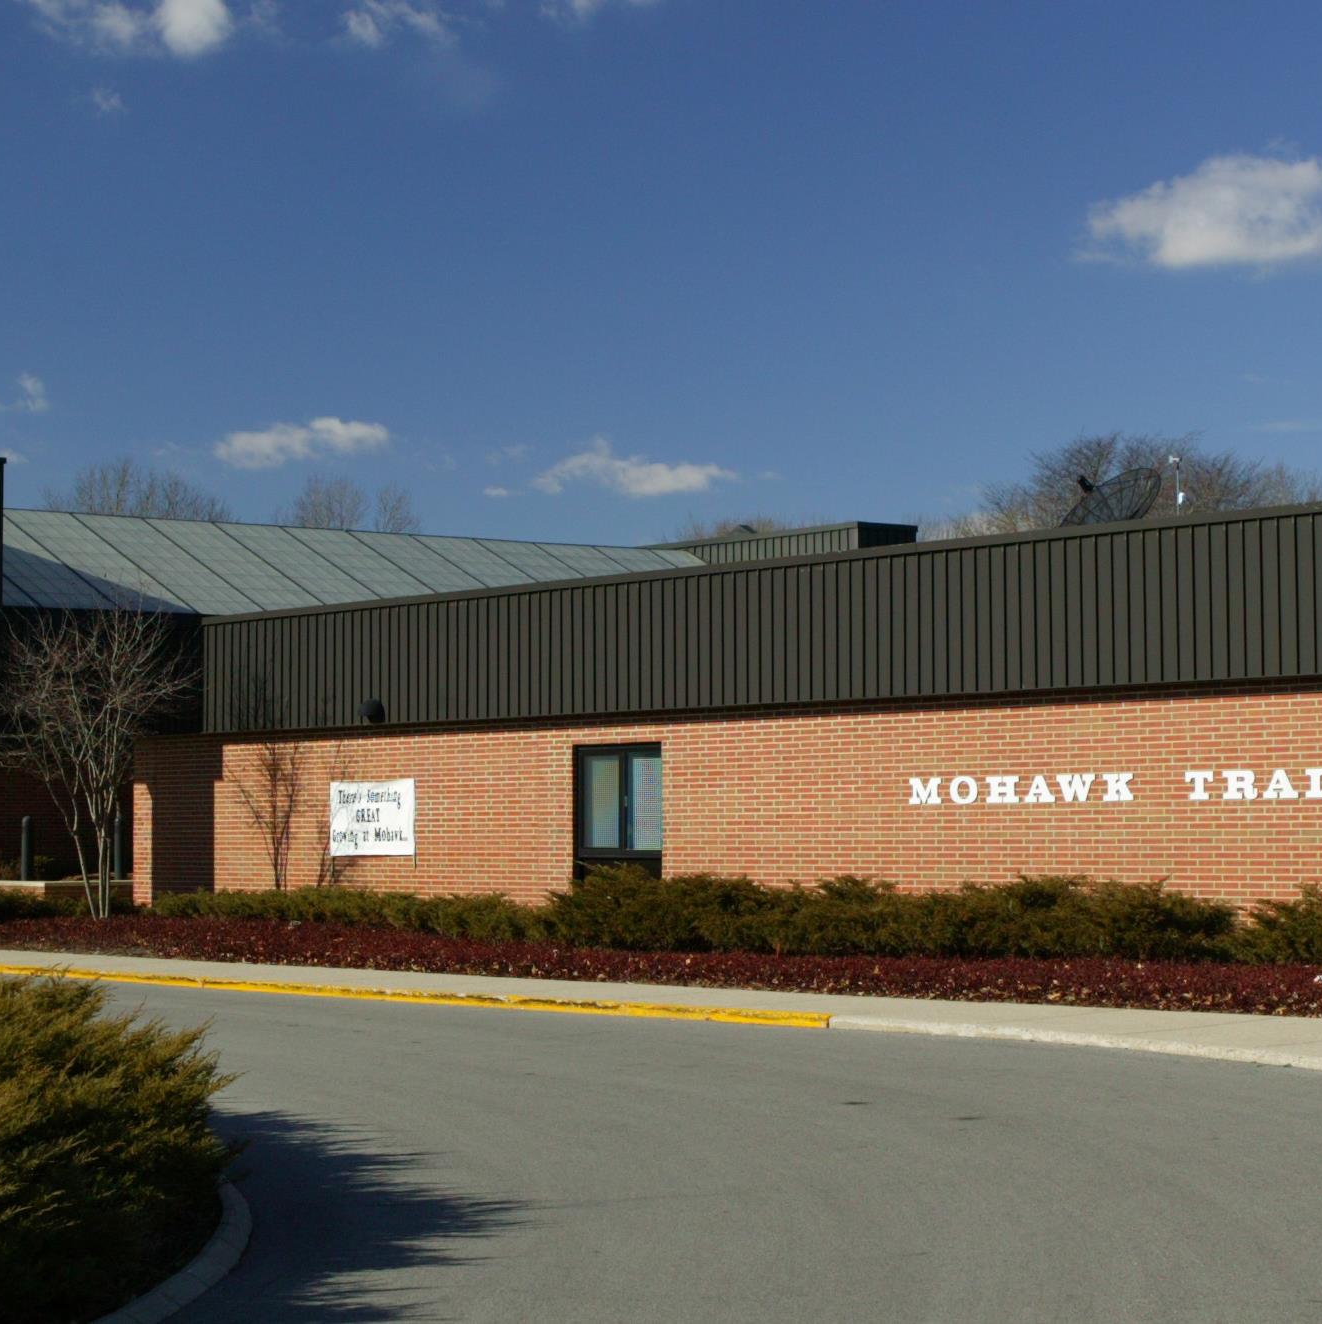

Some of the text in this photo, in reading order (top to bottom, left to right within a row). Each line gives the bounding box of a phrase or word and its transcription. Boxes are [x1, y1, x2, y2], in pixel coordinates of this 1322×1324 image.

[338, 789, 362, 804] There's
[907, 772, 1134, 805] MOHAWK
[356, 808, 380, 823] GREAT
[332, 829, 358, 849] Growing
[363, 831, 369, 842] at
